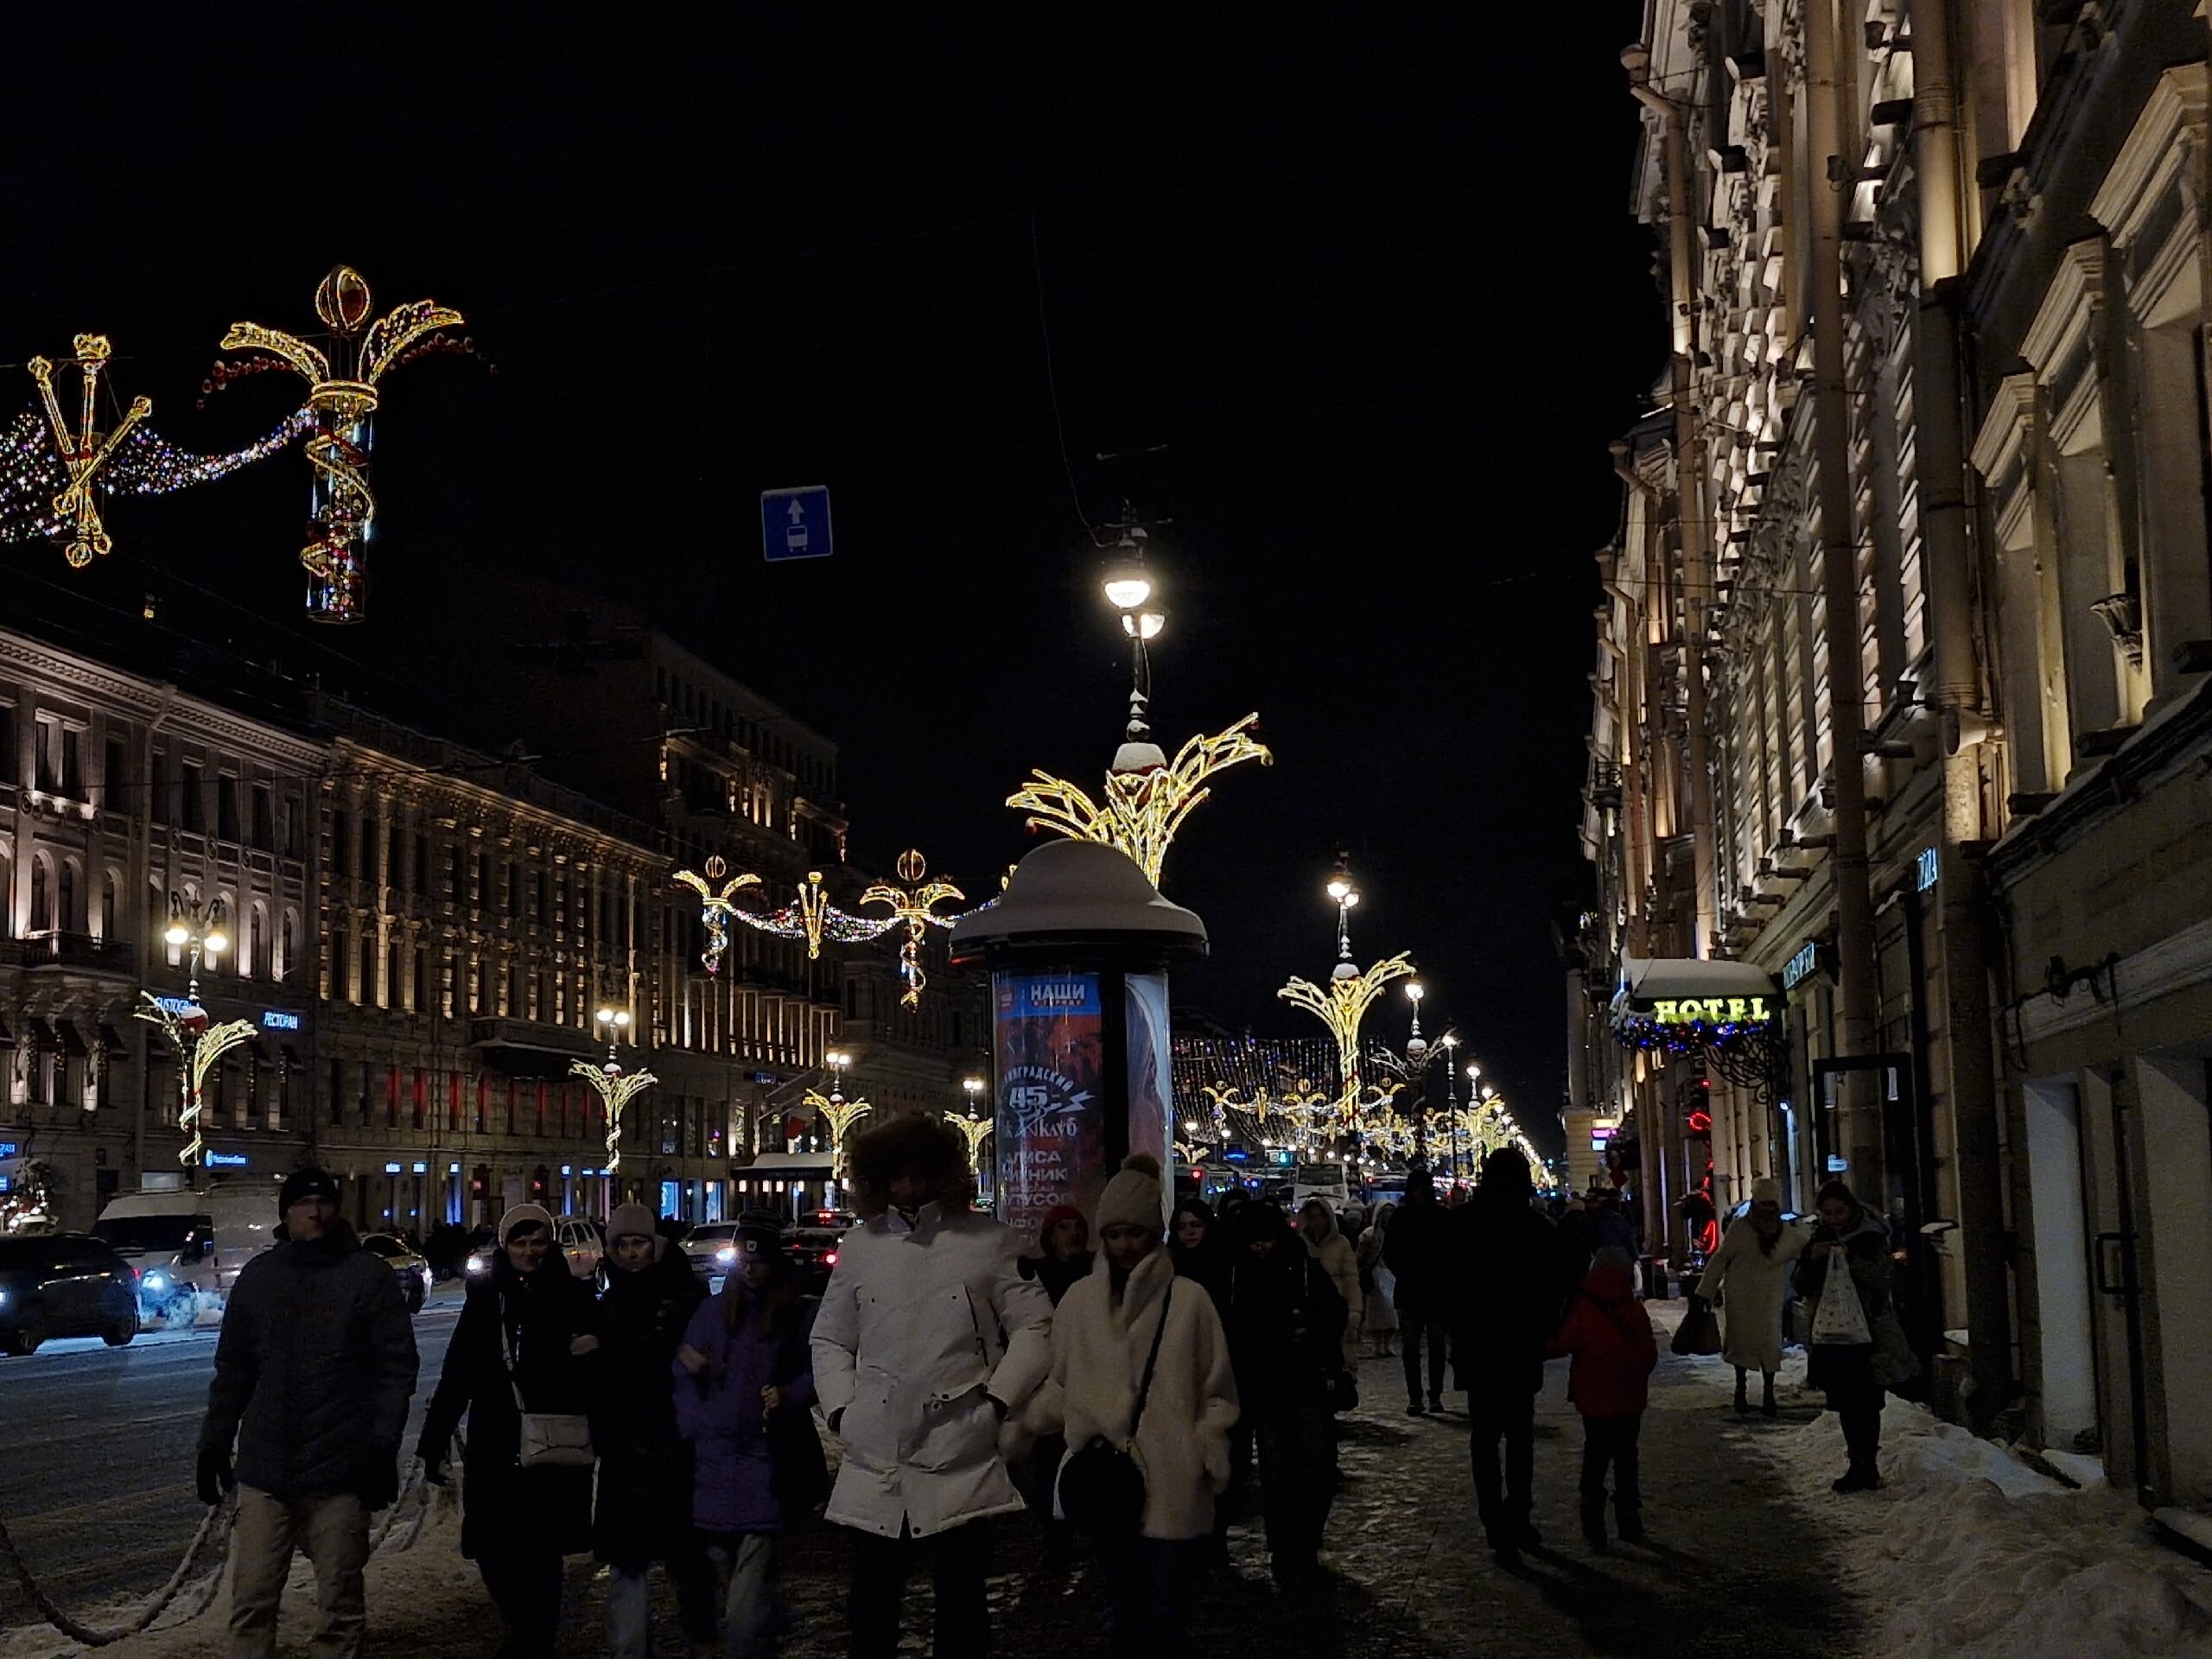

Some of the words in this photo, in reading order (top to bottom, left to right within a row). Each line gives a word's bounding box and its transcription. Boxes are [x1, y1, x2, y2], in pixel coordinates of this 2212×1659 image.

[1031, 983, 1085, 1001] НАШИ
[1654, 998, 1770, 1023] HOTEL
[1009, 1086, 1048, 1110] 45
